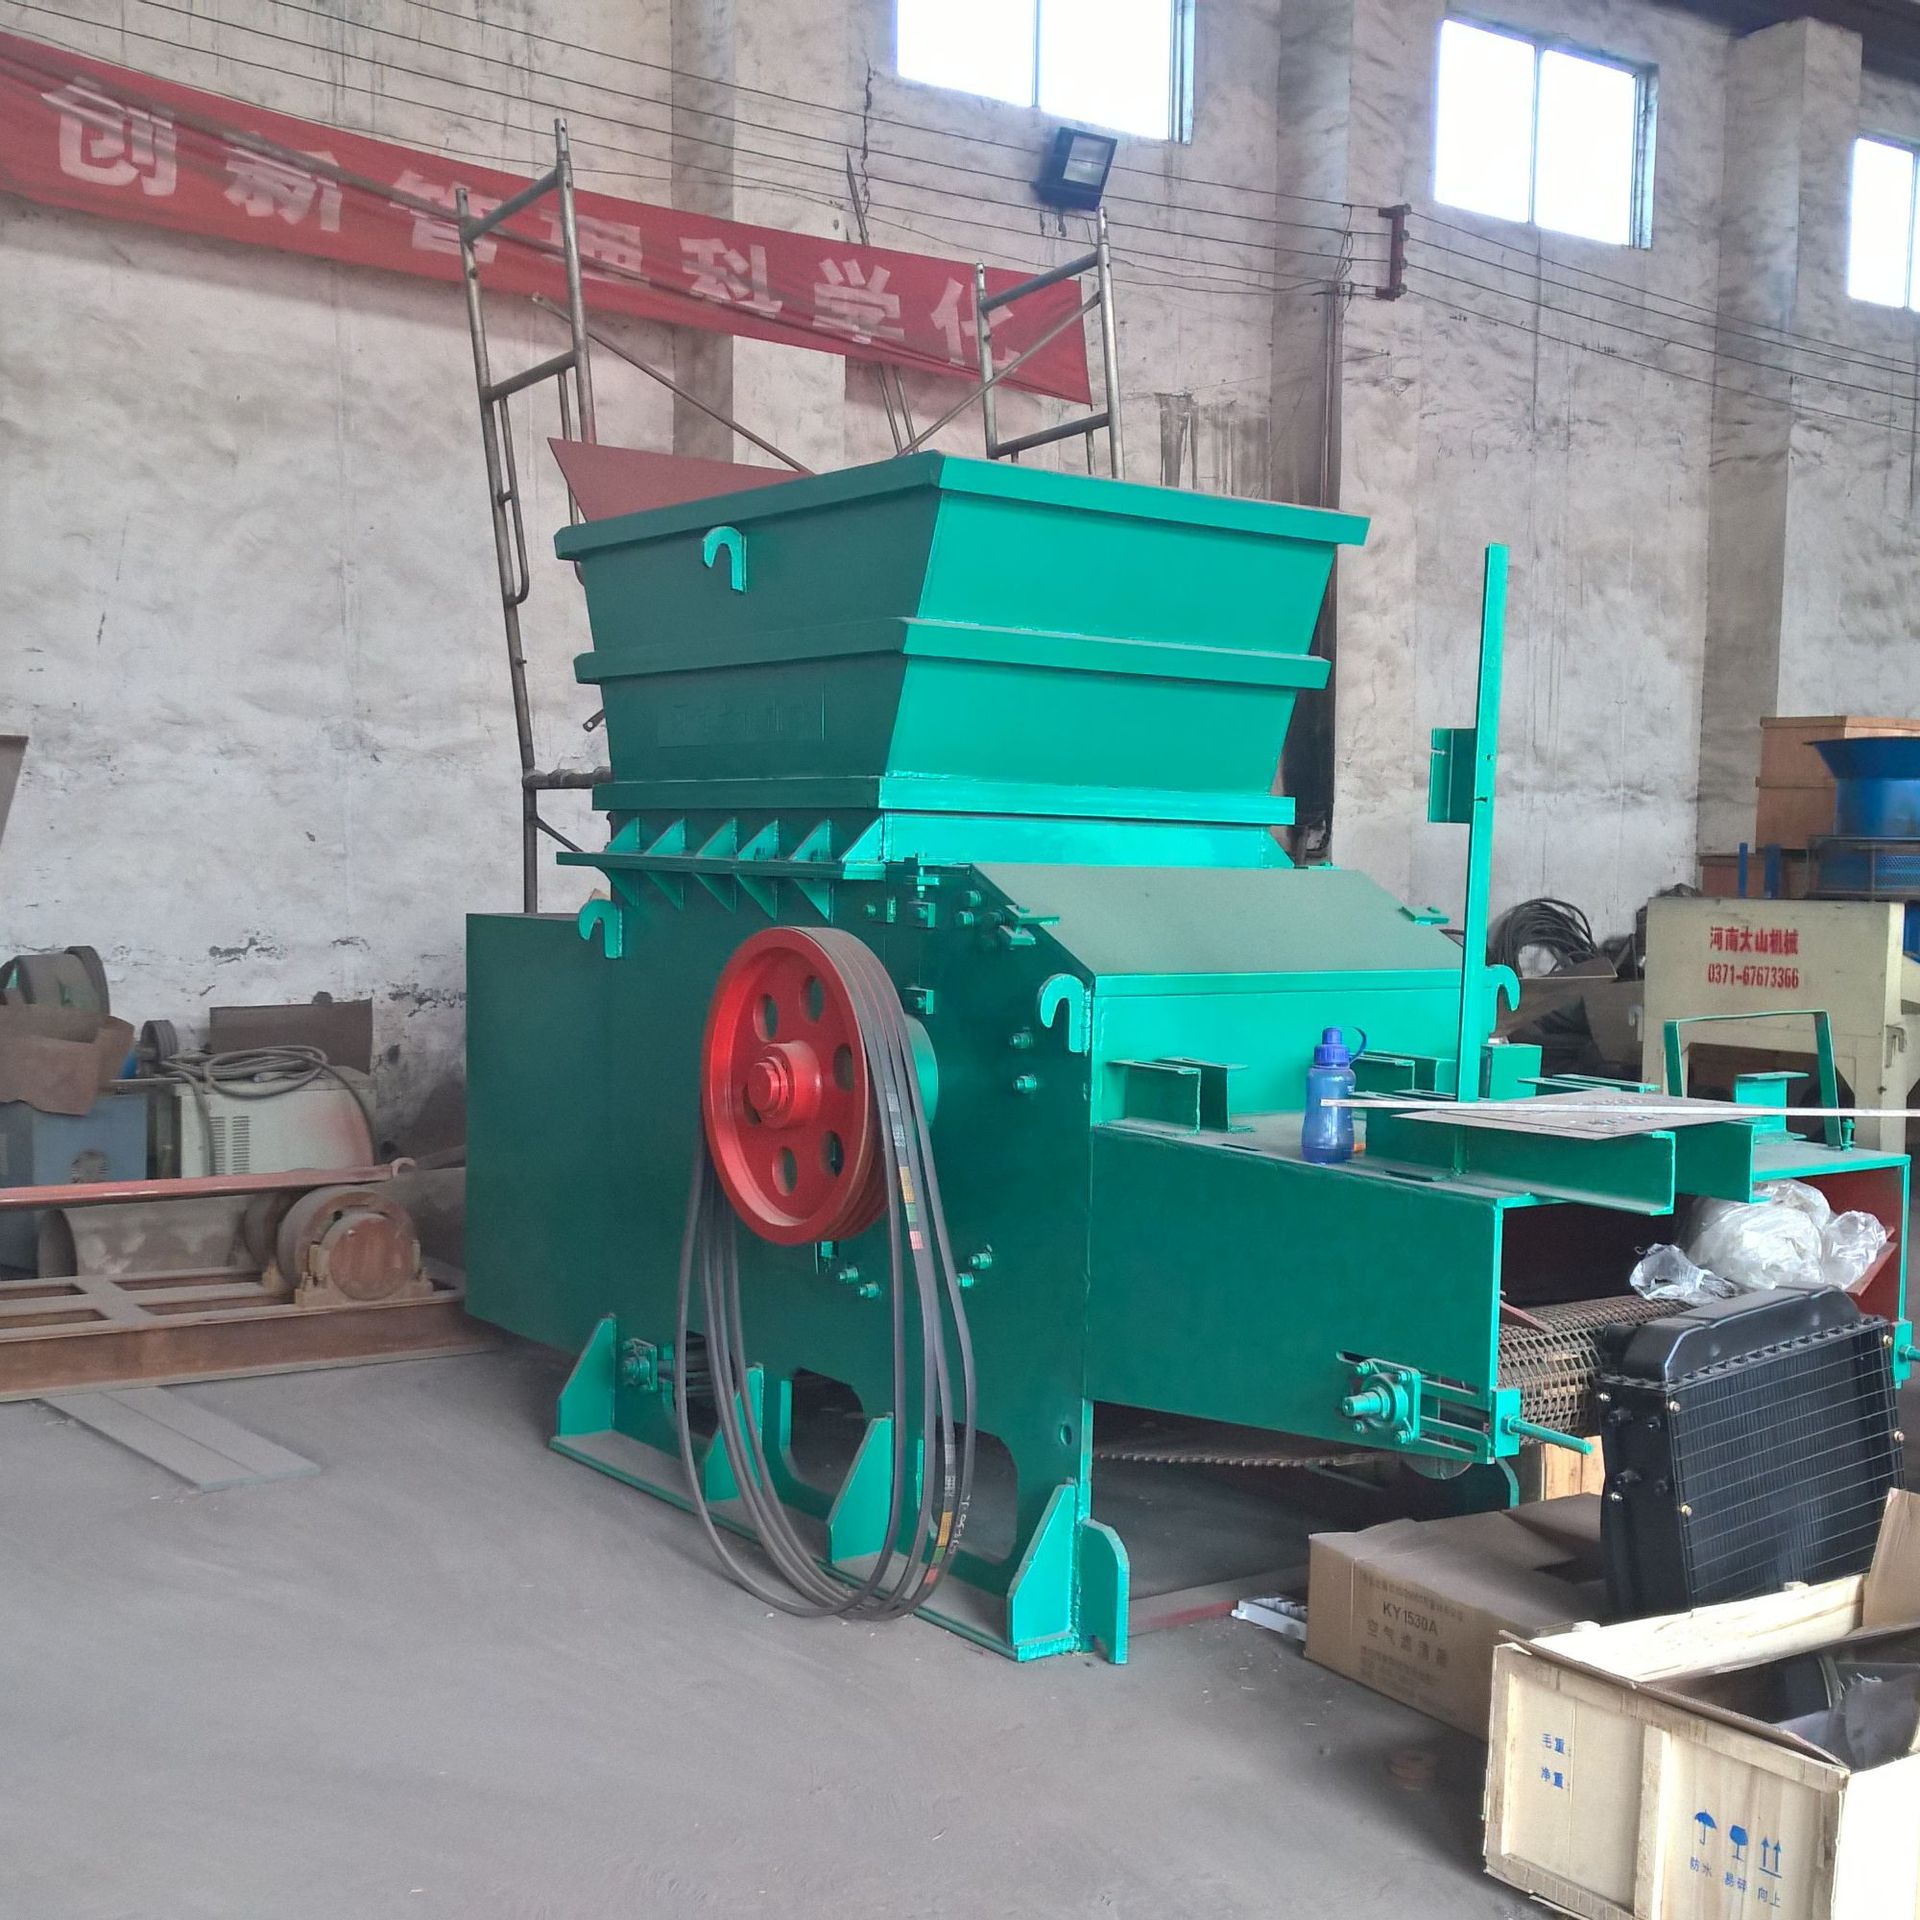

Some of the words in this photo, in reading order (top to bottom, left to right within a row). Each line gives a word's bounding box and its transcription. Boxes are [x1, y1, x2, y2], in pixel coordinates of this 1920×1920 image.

[1709, 925, 1800, 955] 河南大山机械
[1707, 962, 1800, 989] 0371-67673366
[1757, 1886, 1782, 1909] 向上
